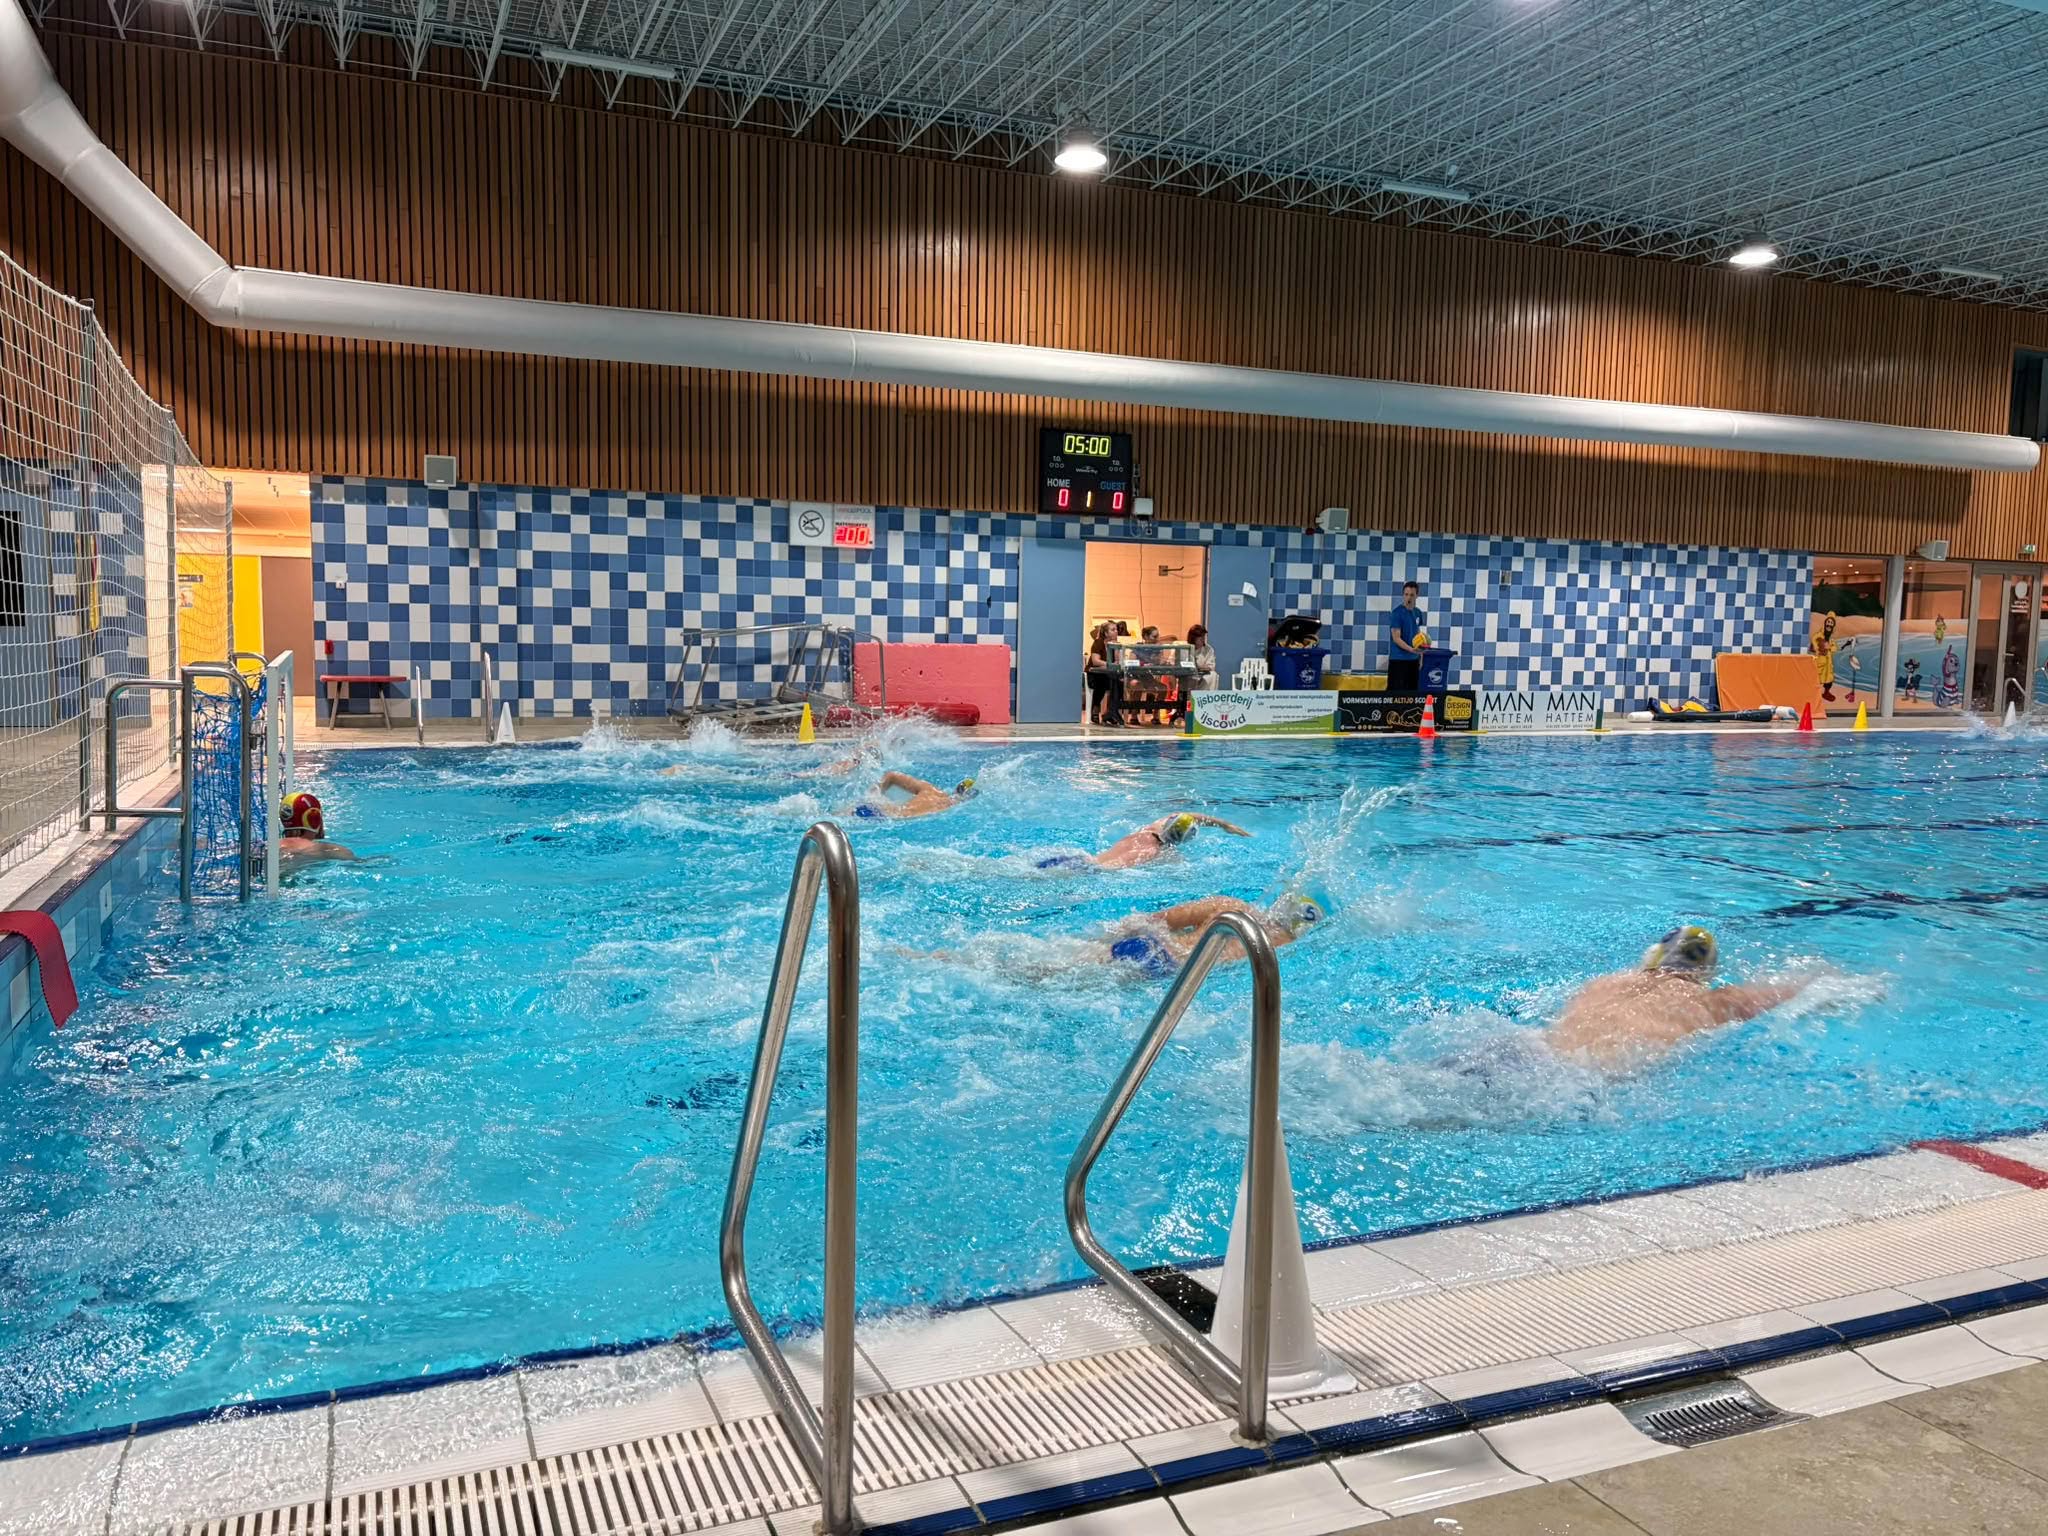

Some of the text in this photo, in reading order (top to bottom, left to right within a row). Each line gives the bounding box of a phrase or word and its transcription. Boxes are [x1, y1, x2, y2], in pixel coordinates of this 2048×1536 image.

[1064, 435, 1110, 455] 05:00
[1047, 478, 1071, 488] HOME
[1100, 481, 1127, 491] GUEST
[1058, 488, 1069, 507] 0
[1086, 491, 1092, 508] 1
[1112, 492, 1124, 509] 0
[834, 528, 869, 545] 200
[1197, 693, 1253, 710] ijsboerderij
[1483, 692, 1534, 711] MAN
[1547, 692, 1595, 711] MAN
[1482, 713, 1533, 723] HATTEM
[1546, 713, 1594, 722] HATTEM
[1304, 905, 1315, 921] 5
